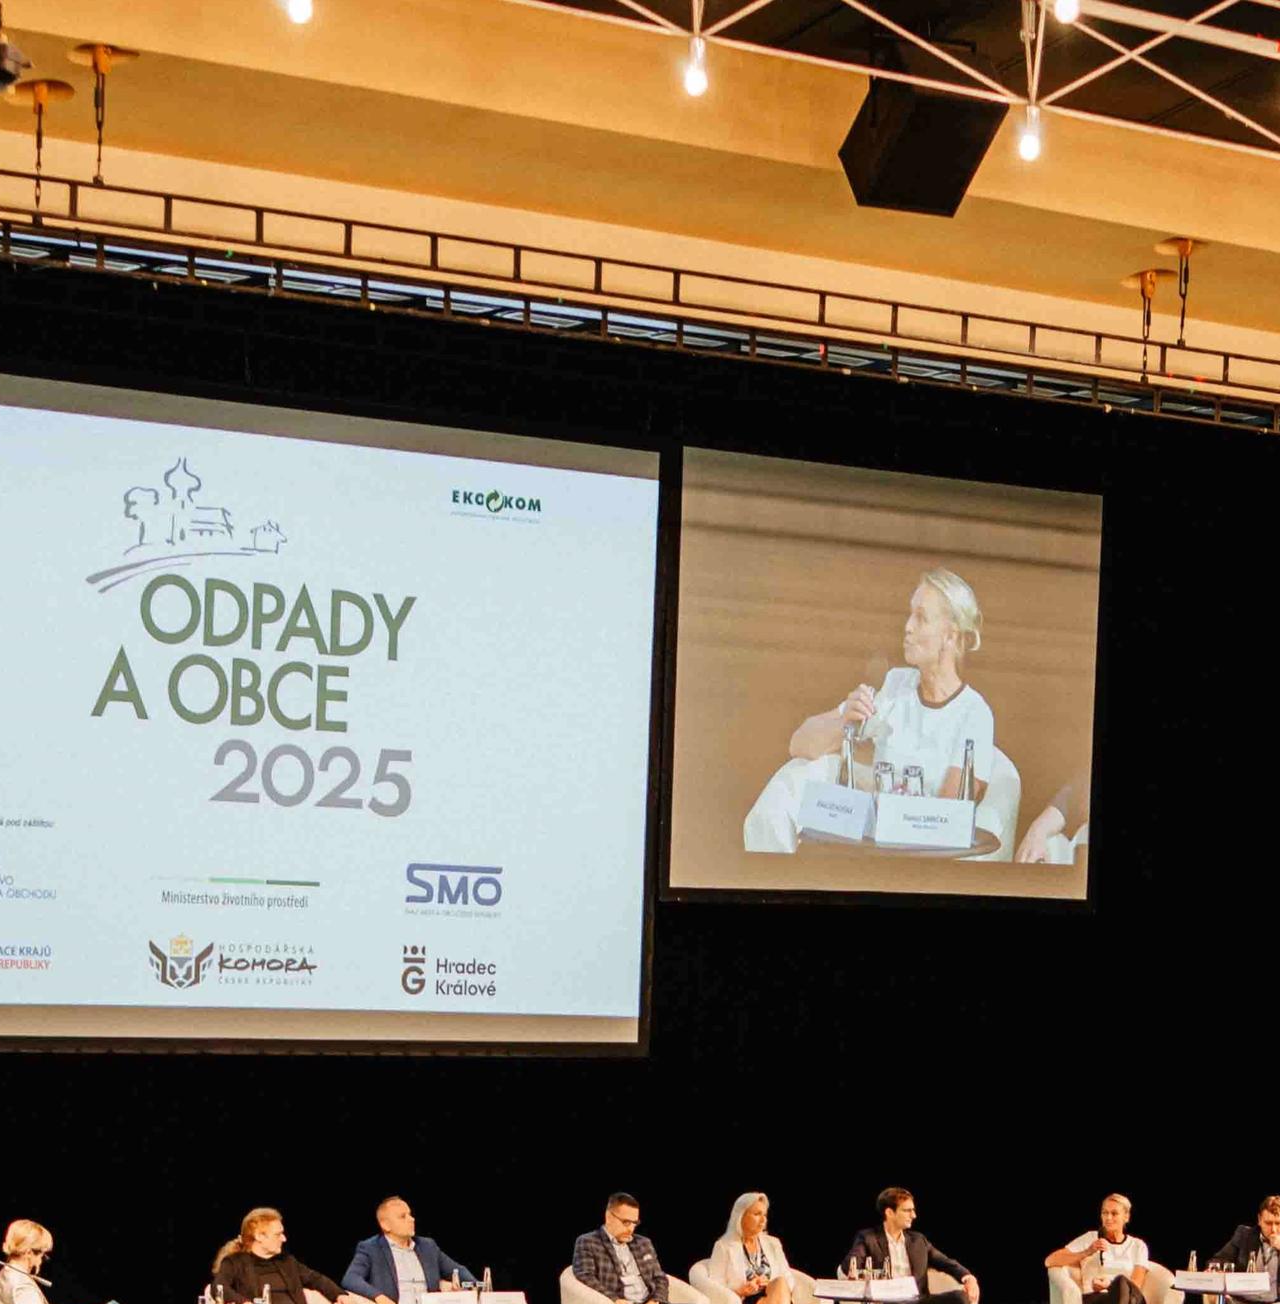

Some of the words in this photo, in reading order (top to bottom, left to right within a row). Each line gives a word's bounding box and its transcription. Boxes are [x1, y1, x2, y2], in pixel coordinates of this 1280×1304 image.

[140, 573, 417, 661] ODPADY
[90, 645, 149, 720] A
[168, 653, 350, 733] OBCE
[209, 739, 413, 818] 2025
[405, 863, 504, 906] SMO
[161, 890, 220, 906] Ministerstvo
[221, 891, 265, 908] životního
[267, 894, 309, 910] prostředí
[18, 944, 52, 957] KRAJŮ
[218, 953, 318, 975] KOMORA
[436, 957, 497, 975] Hradec
[435, 978, 497, 996] Králové
